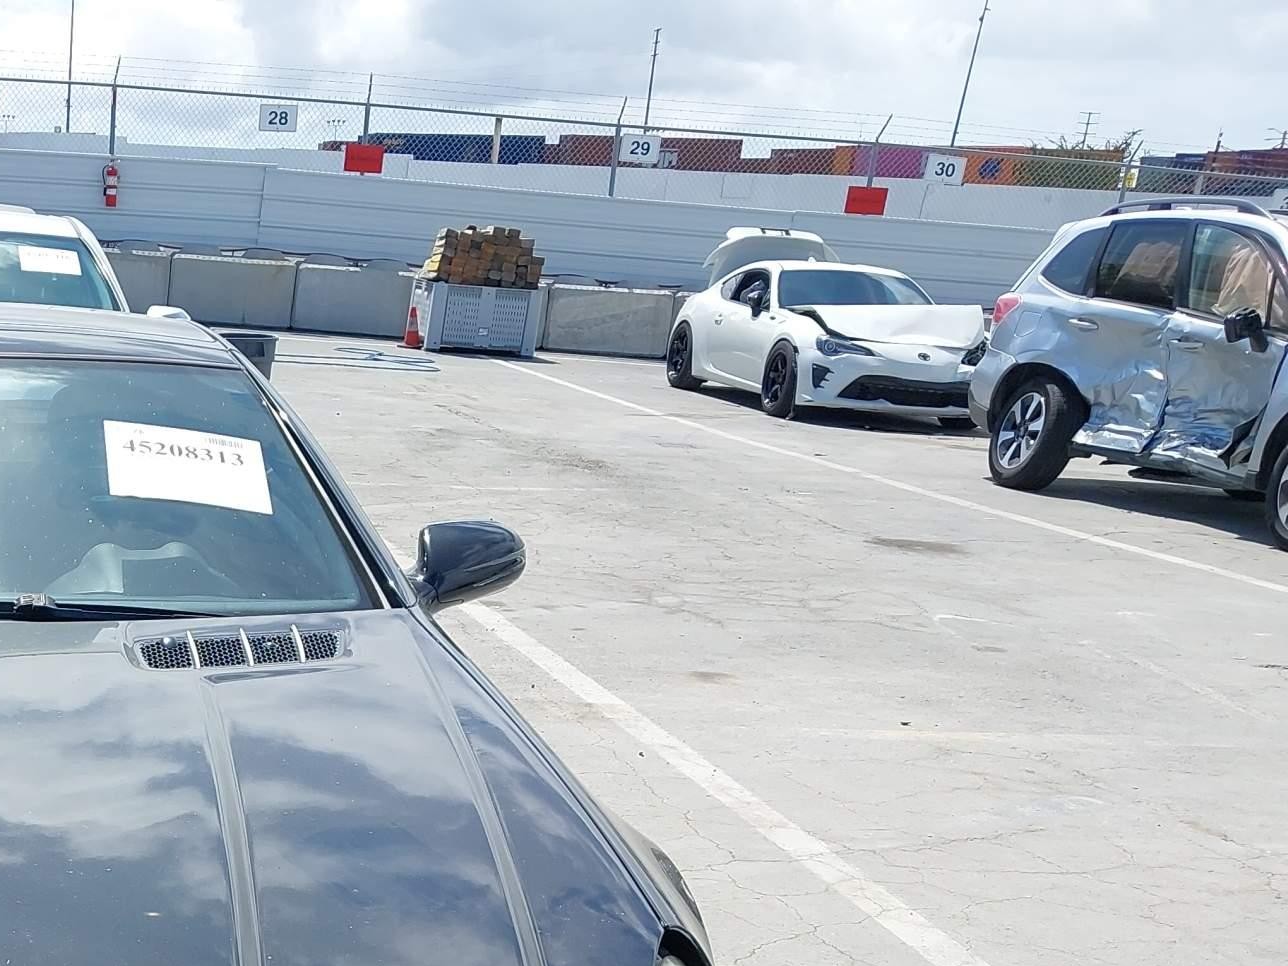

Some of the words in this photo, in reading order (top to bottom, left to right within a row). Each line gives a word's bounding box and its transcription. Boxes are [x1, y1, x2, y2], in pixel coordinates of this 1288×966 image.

[268, 110, 289, 126] 28
[629, 141, 651, 156] 29
[935, 161, 956, 178] 30
[123, 439, 245, 466] 45208313
